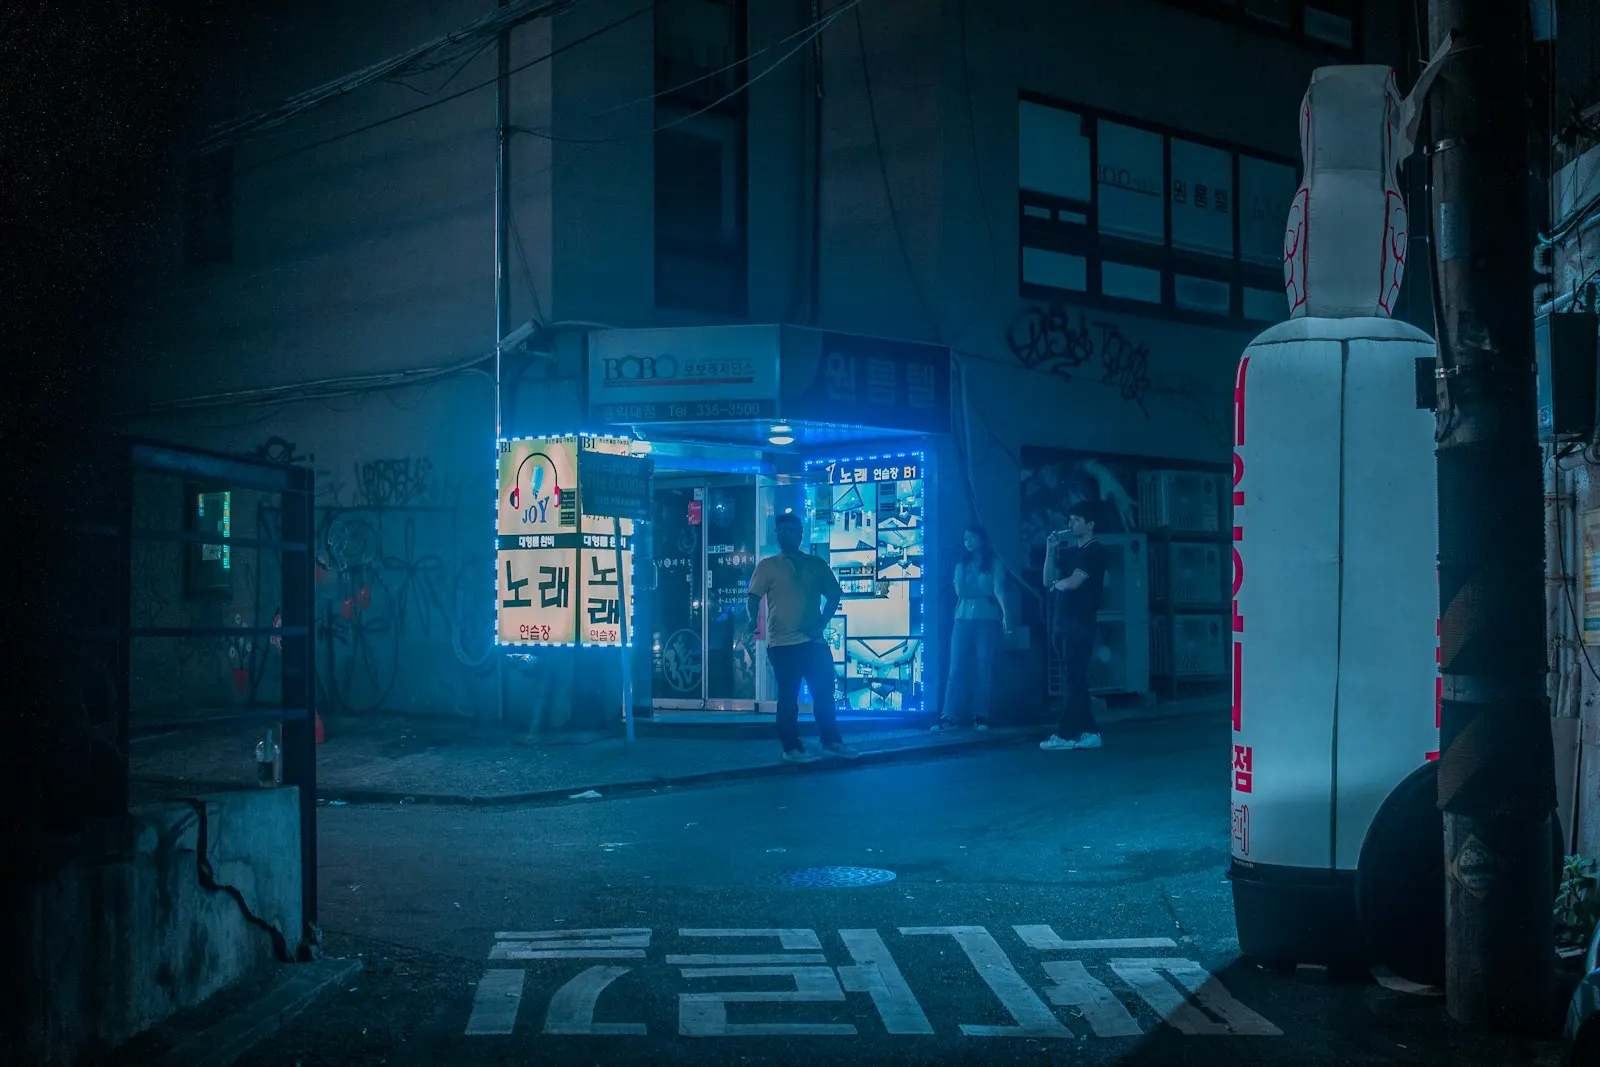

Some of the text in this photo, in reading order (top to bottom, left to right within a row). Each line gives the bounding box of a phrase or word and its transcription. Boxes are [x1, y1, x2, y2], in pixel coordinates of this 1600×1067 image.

[602, 354, 679, 381] BOBO
[696, 402, 760, 418] 338-3500
[500, 441, 512, 453] B1
[583, 437, 596, 449] B1
[839, 467, 868, 484] 노래
[873, 467, 899, 481] 연습장
[903, 466, 916, 478] B1
[522, 496, 551, 524] JOY
[502, 560, 570, 608] 노래
[587, 556, 621, 624] 노래
[519, 624, 551, 641] 연습장
[590, 629, 617, 642] 연습장
[1231, 744, 1253, 794] 점
